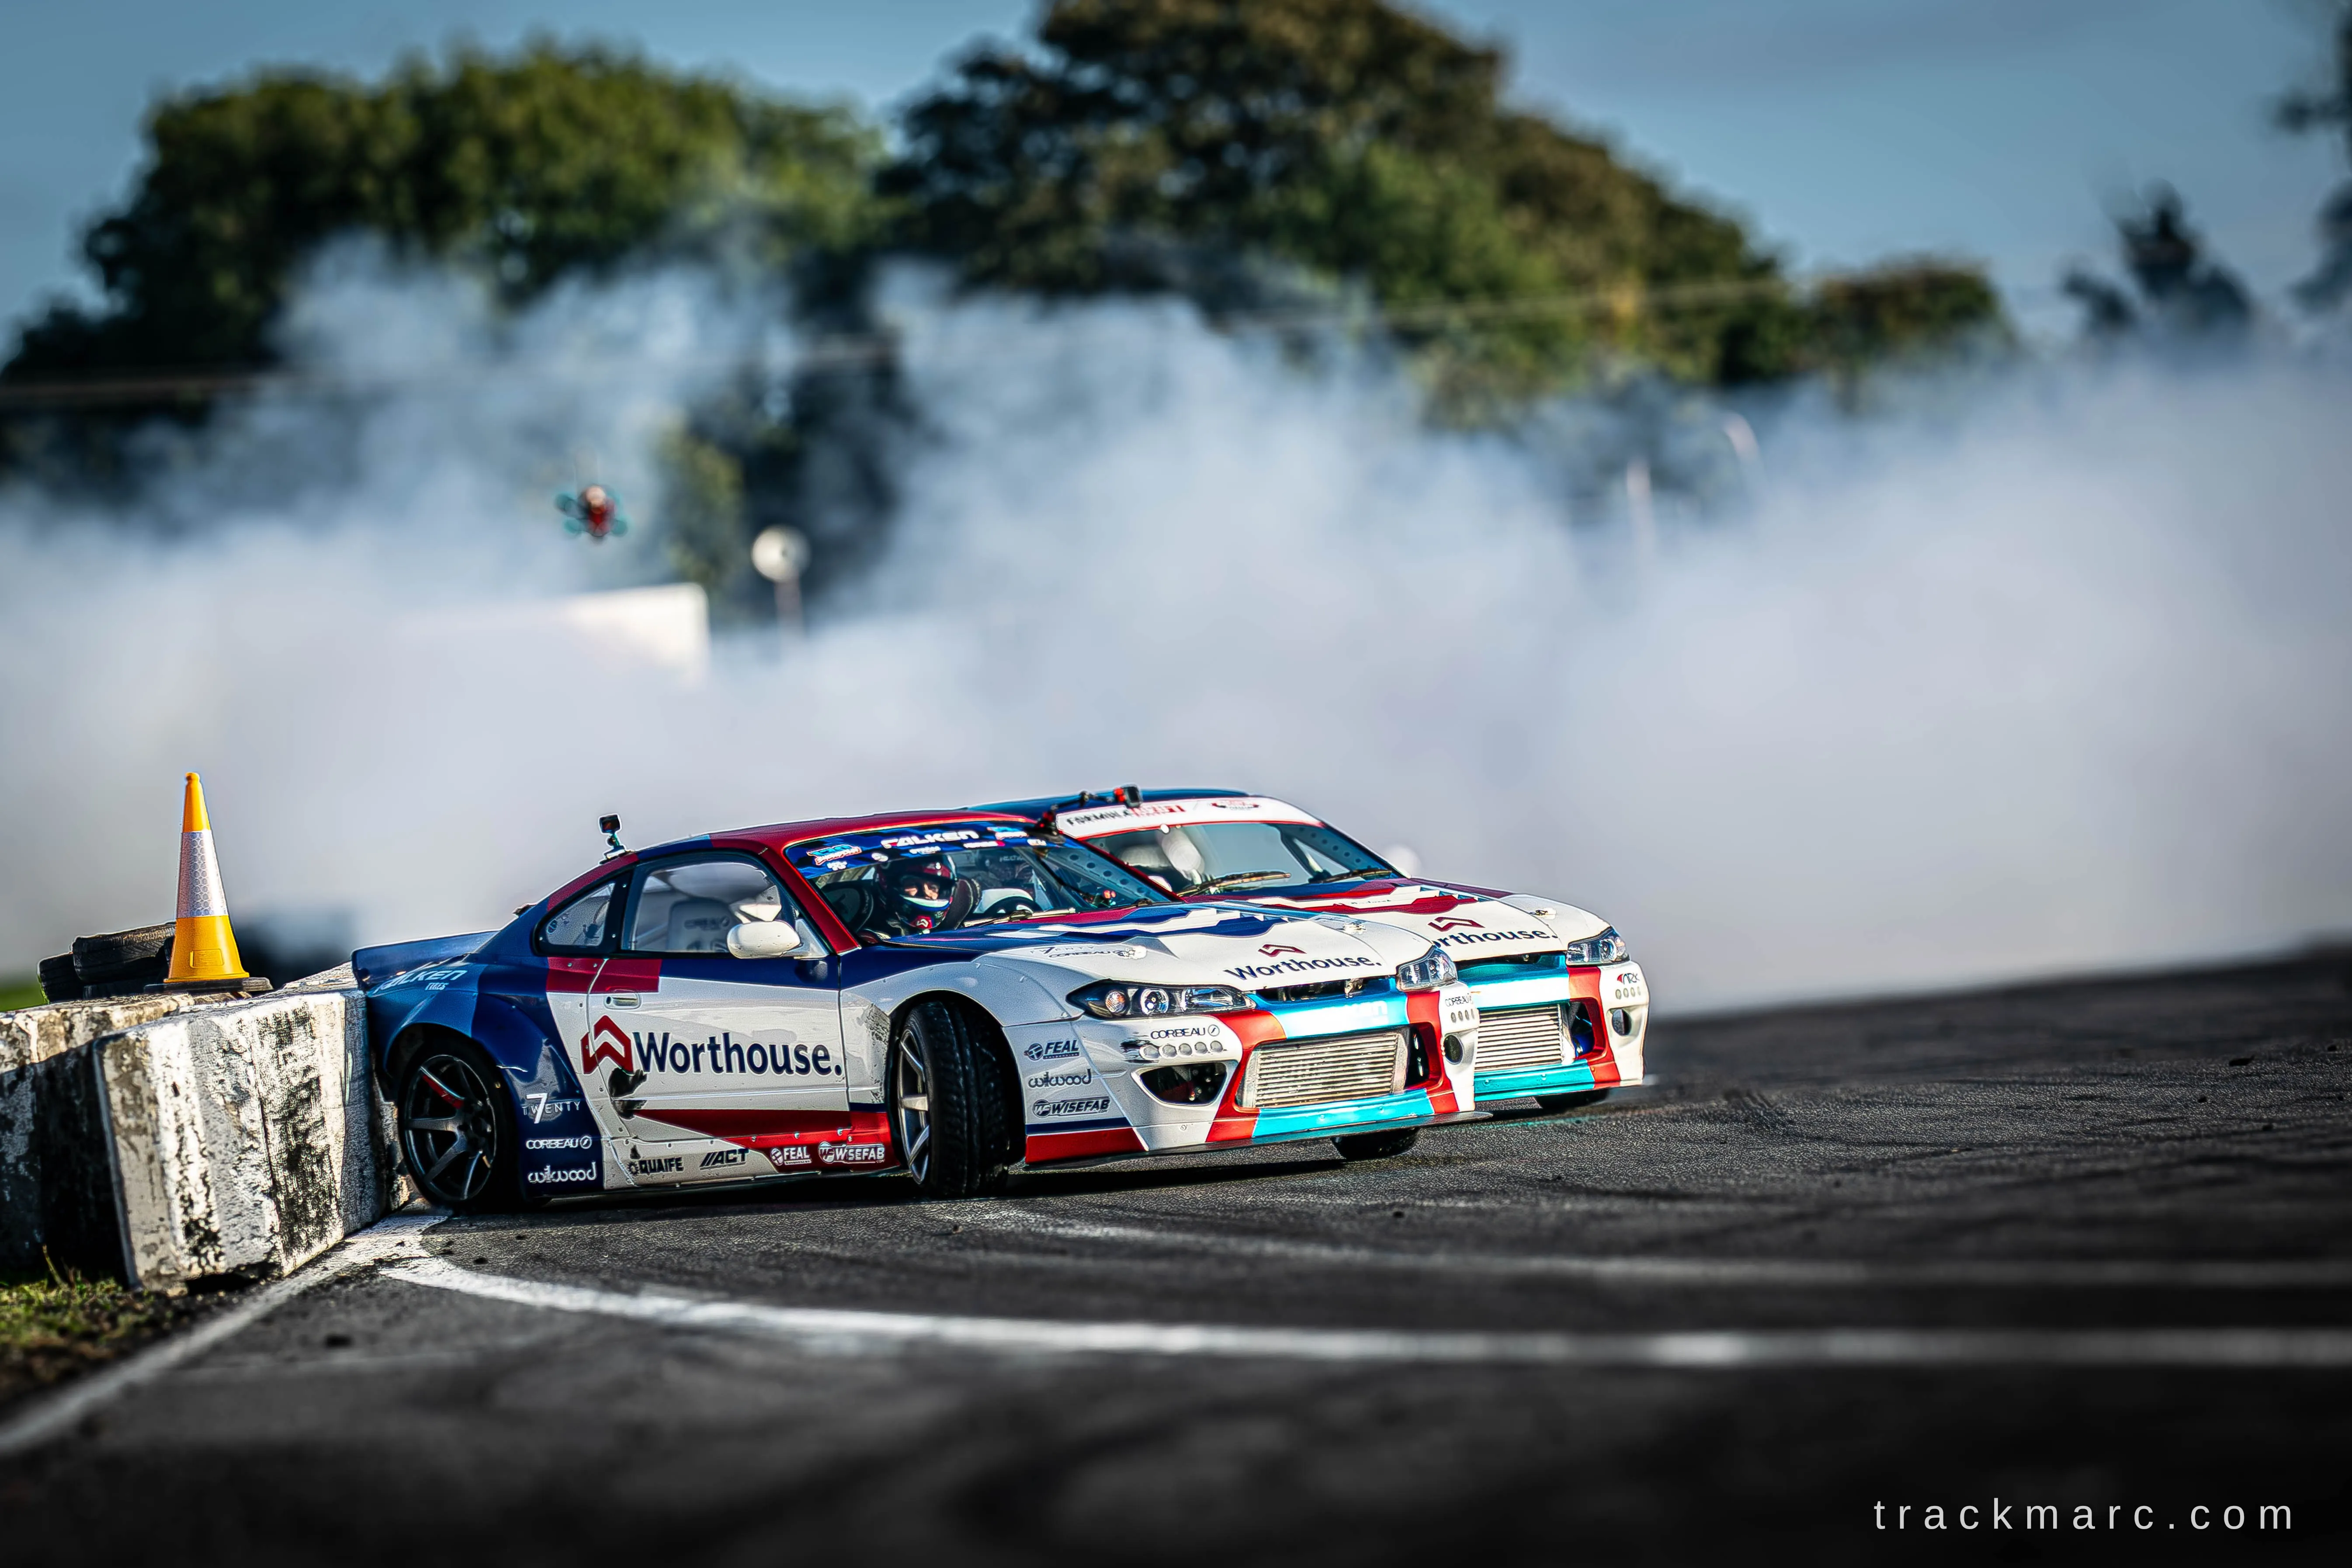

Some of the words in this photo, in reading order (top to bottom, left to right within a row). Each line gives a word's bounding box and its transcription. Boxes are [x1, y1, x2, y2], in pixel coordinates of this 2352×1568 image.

[881, 830, 979, 849] FALKEN
[1432, 930, 1559, 948] rthouse.
[1223, 957, 1382, 981] Worthouse.
[1150, 1027, 1206, 1039] CORBEAU
[632, 1032, 842, 1075] Worthouse.
[1044, 1040, 1079, 1055] FEAL
[1051, 1099, 1110, 1114] WISEFAB
[526, 1138, 579, 1149] CORBEAU
[784, 1146, 810, 1159] FEAL
[836, 1147, 885, 1160] WSEFAB
[638, 1157, 684, 1174] QUAIFE
